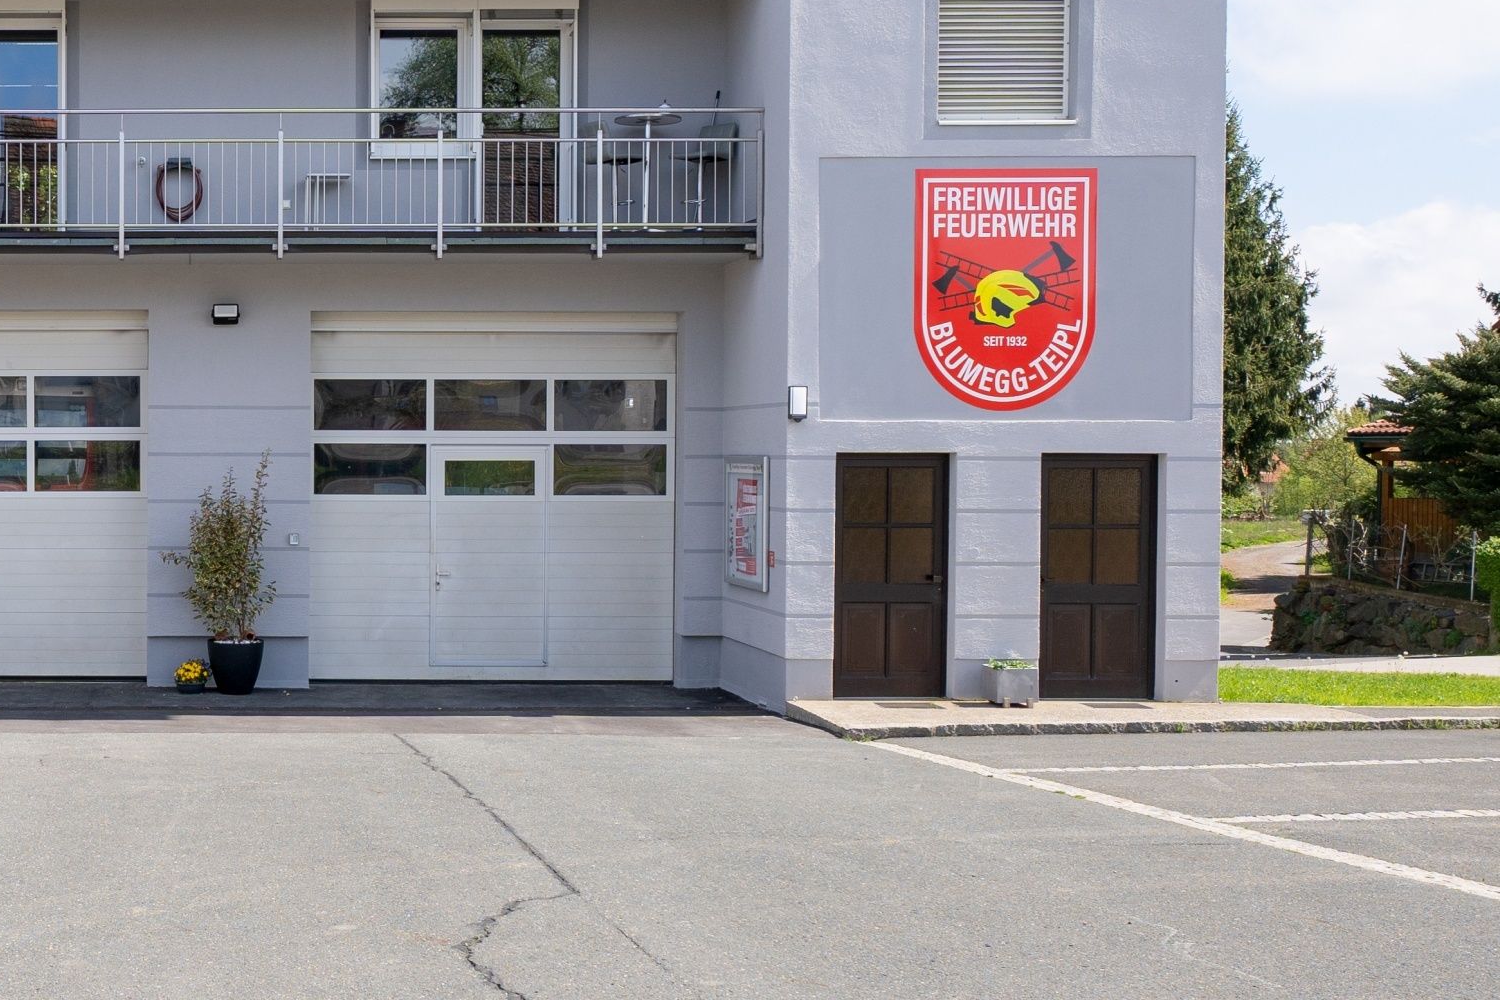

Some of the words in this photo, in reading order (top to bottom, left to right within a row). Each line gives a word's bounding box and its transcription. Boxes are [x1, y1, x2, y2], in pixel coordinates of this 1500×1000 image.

[933, 187, 1077, 211] FREIWILLIGE
[933, 213, 1077, 238] FEUERWEHR
[983, 335, 1004, 347] SEIT
[1006, 335, 1028, 347] 1932
[929, 319, 1081, 394] BLUMEGG-TEIPL
